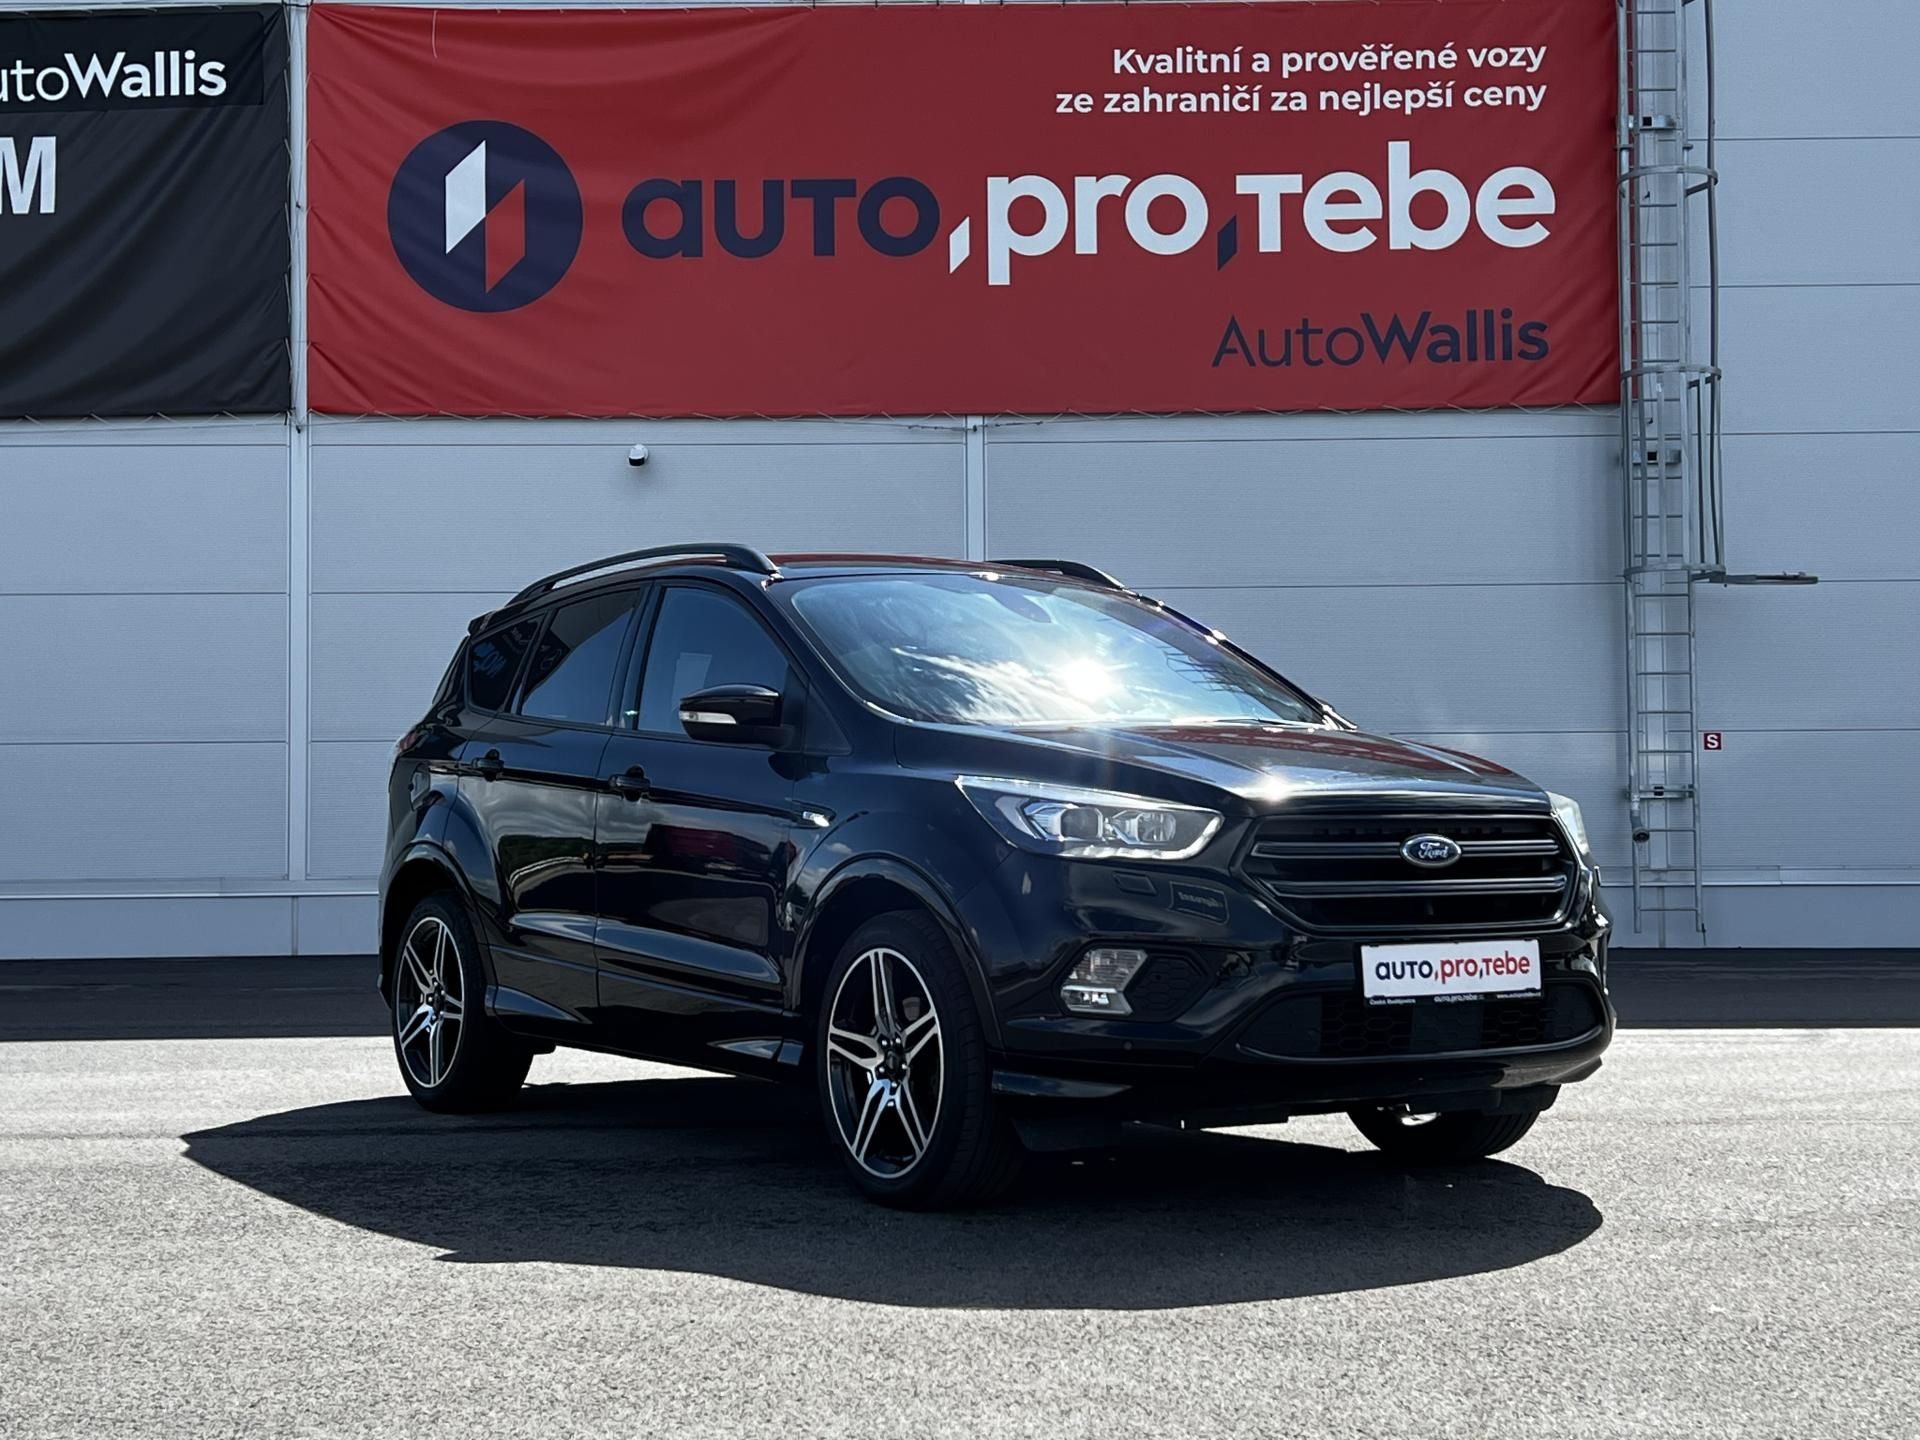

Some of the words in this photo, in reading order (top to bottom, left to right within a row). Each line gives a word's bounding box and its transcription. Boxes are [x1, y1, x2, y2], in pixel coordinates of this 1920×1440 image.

[0, 50, 227, 102] toWallis
[1112, 45, 1244, 75] Kvalitní
[1250, 52, 1271, 74] a
[1281, 42, 1458, 79] prověřené
[1466, 46, 1547, 73] vozy
[1055, 92, 1095, 114] ze
[1103, 84, 1264, 113] zahraničí
[1270, 89, 1308, 113] za
[1319, 81, 1456, 117] nejlepší
[1463, 84, 1548, 112] ceny
[1211, 308, 1550, 368] AutoWallis
[1706, 734, 1719, 749] S
[1418, 841, 1449, 859] Ford
